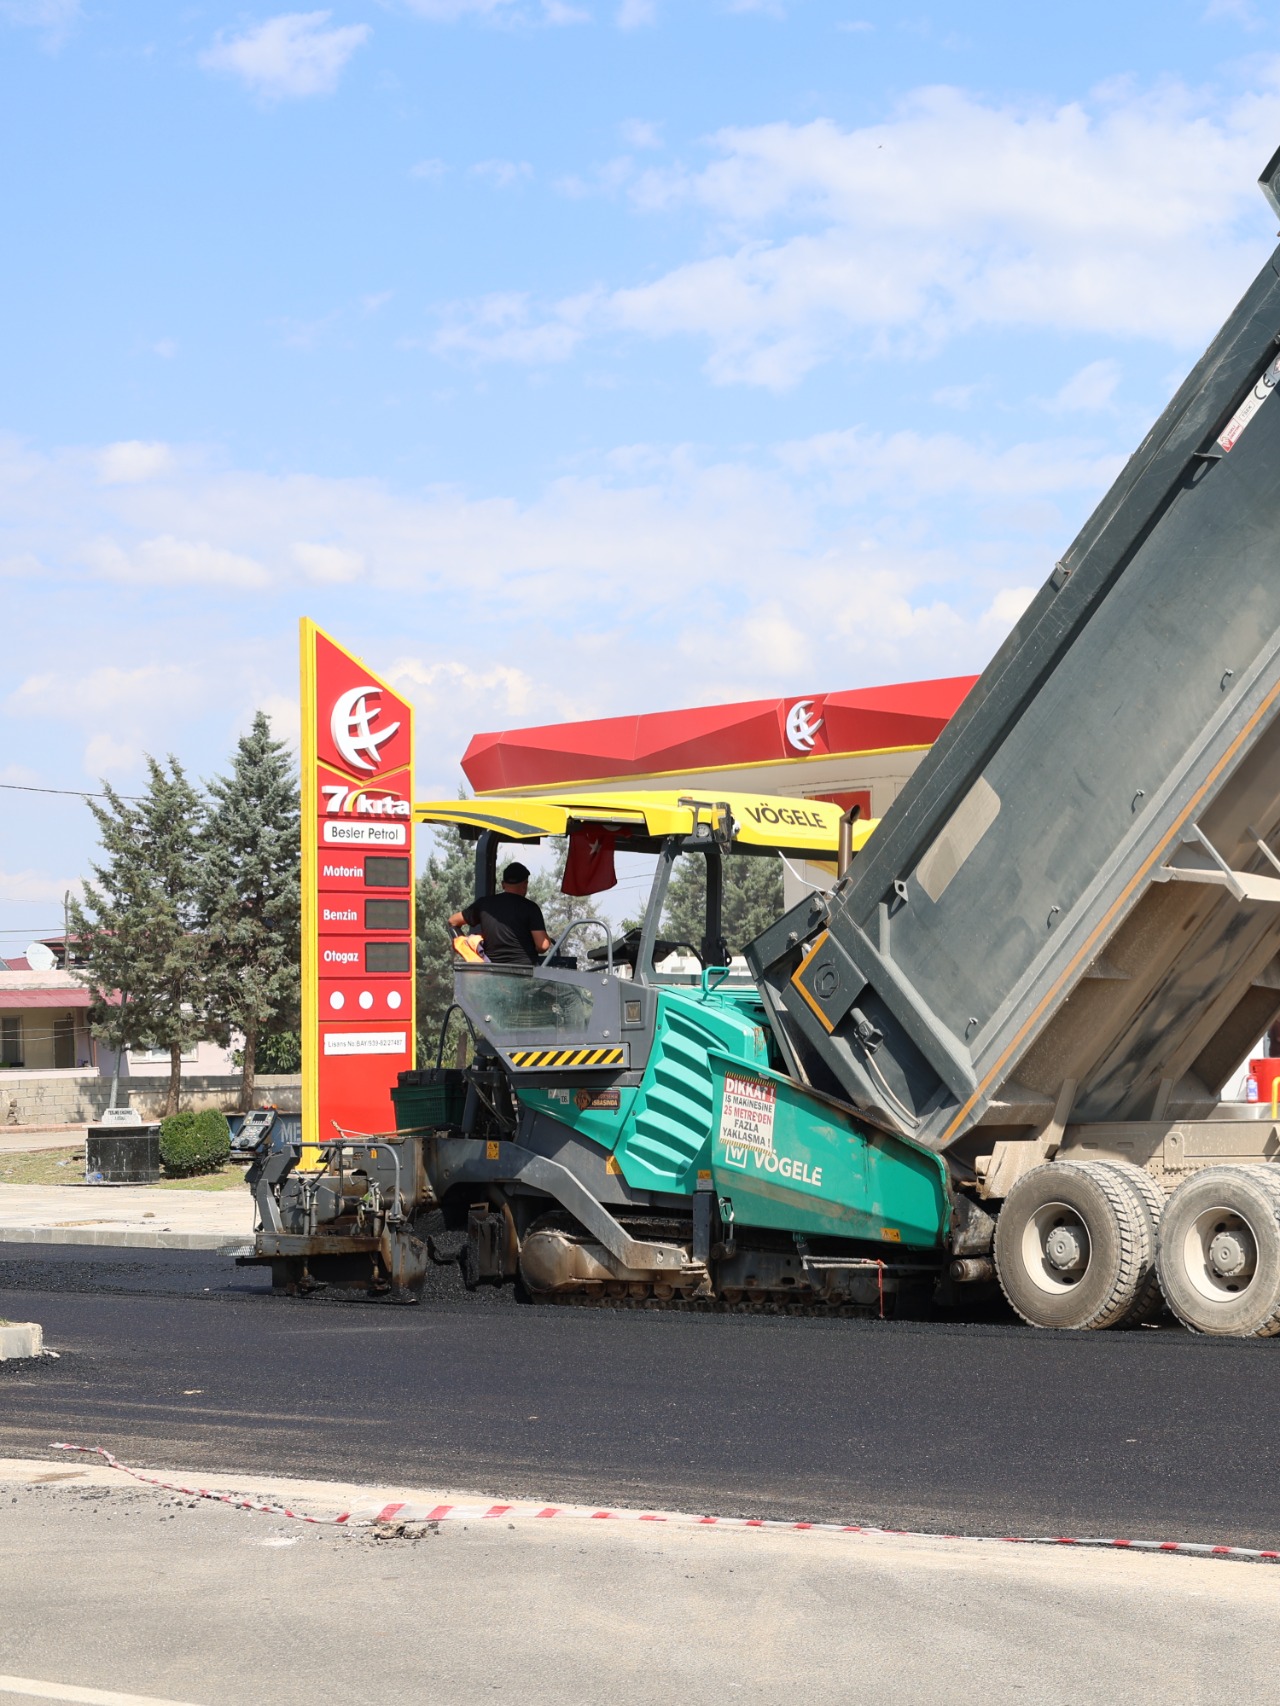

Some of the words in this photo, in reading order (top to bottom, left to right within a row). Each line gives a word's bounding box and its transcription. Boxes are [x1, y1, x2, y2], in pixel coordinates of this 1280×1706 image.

[744, 803, 827, 829] VÖGELE
[331, 826, 365, 839] Besler
[368, 828, 399, 840] Petrol
[323, 865, 363, 877] Motorin
[323, 909, 358, 921] Benzin
[323, 950, 359, 964] Otogaz
[725, 1077, 768, 1100] DİKKAT
[733, 1096, 773, 1113] MAKİNESİNE
[724, 1105, 733, 1116] 25
[734, 1106, 772, 1126] METRE'DEN
[734, 1118, 759, 1133] FAZLA
[754, 1149, 823, 1187] VÖGELE
